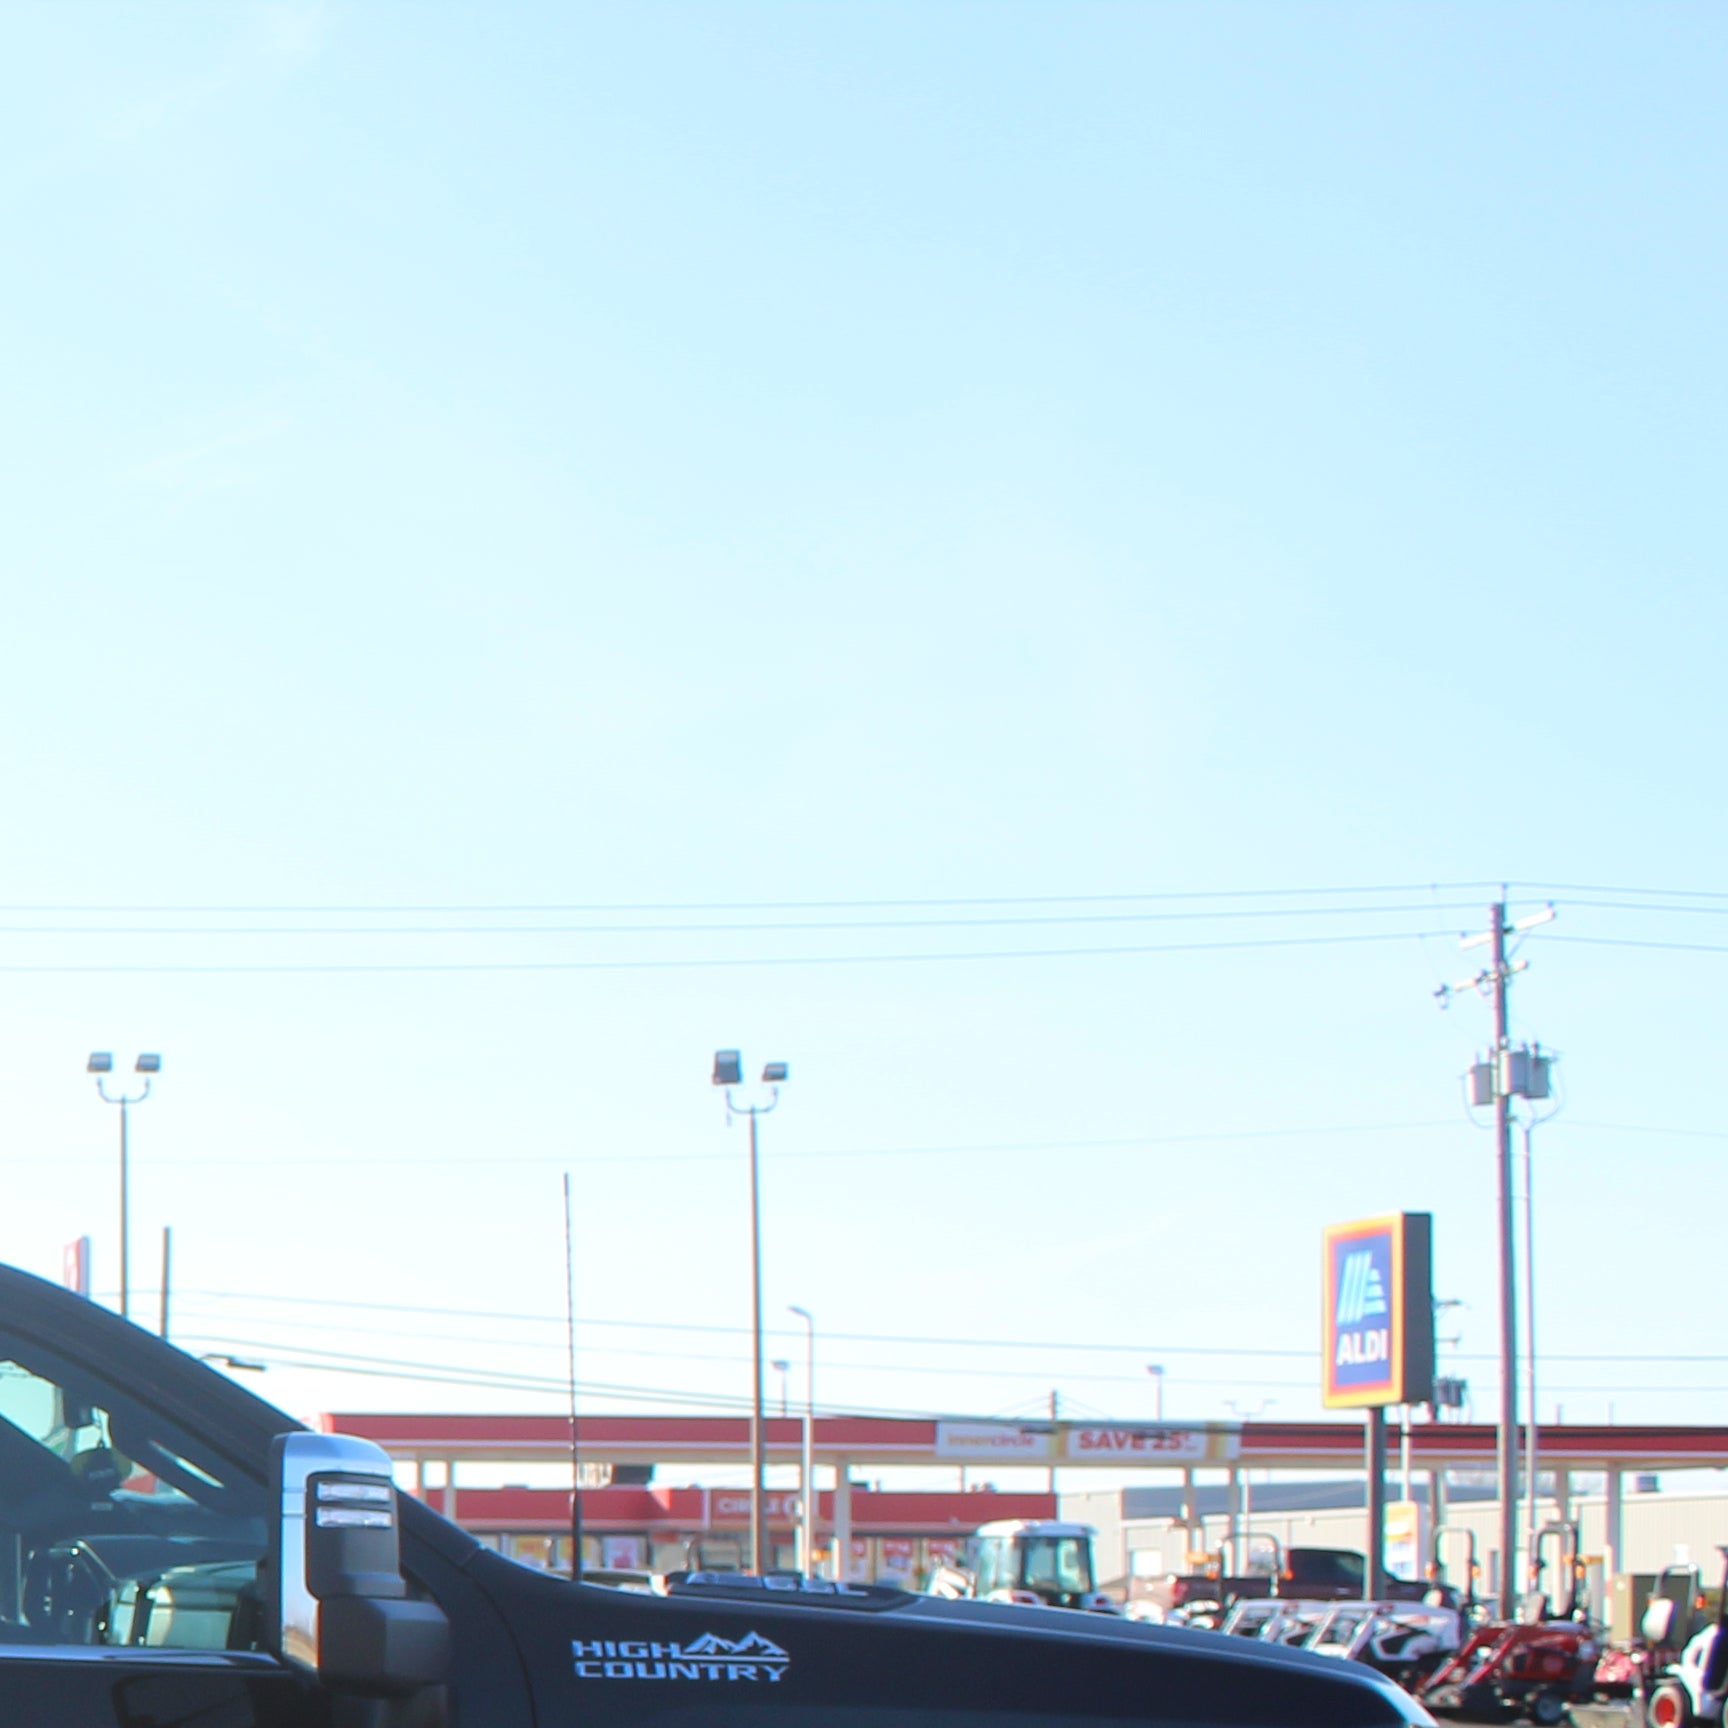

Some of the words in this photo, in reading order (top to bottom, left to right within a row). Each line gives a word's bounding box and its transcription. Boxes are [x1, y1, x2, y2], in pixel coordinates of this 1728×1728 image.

[1335, 1328, 1389, 1367] ALDI
[1078, 1430, 1146, 1451] SAVE
[570, 1640, 681, 1659] HIGH
[575, 1660, 790, 1682] COUNTRY
